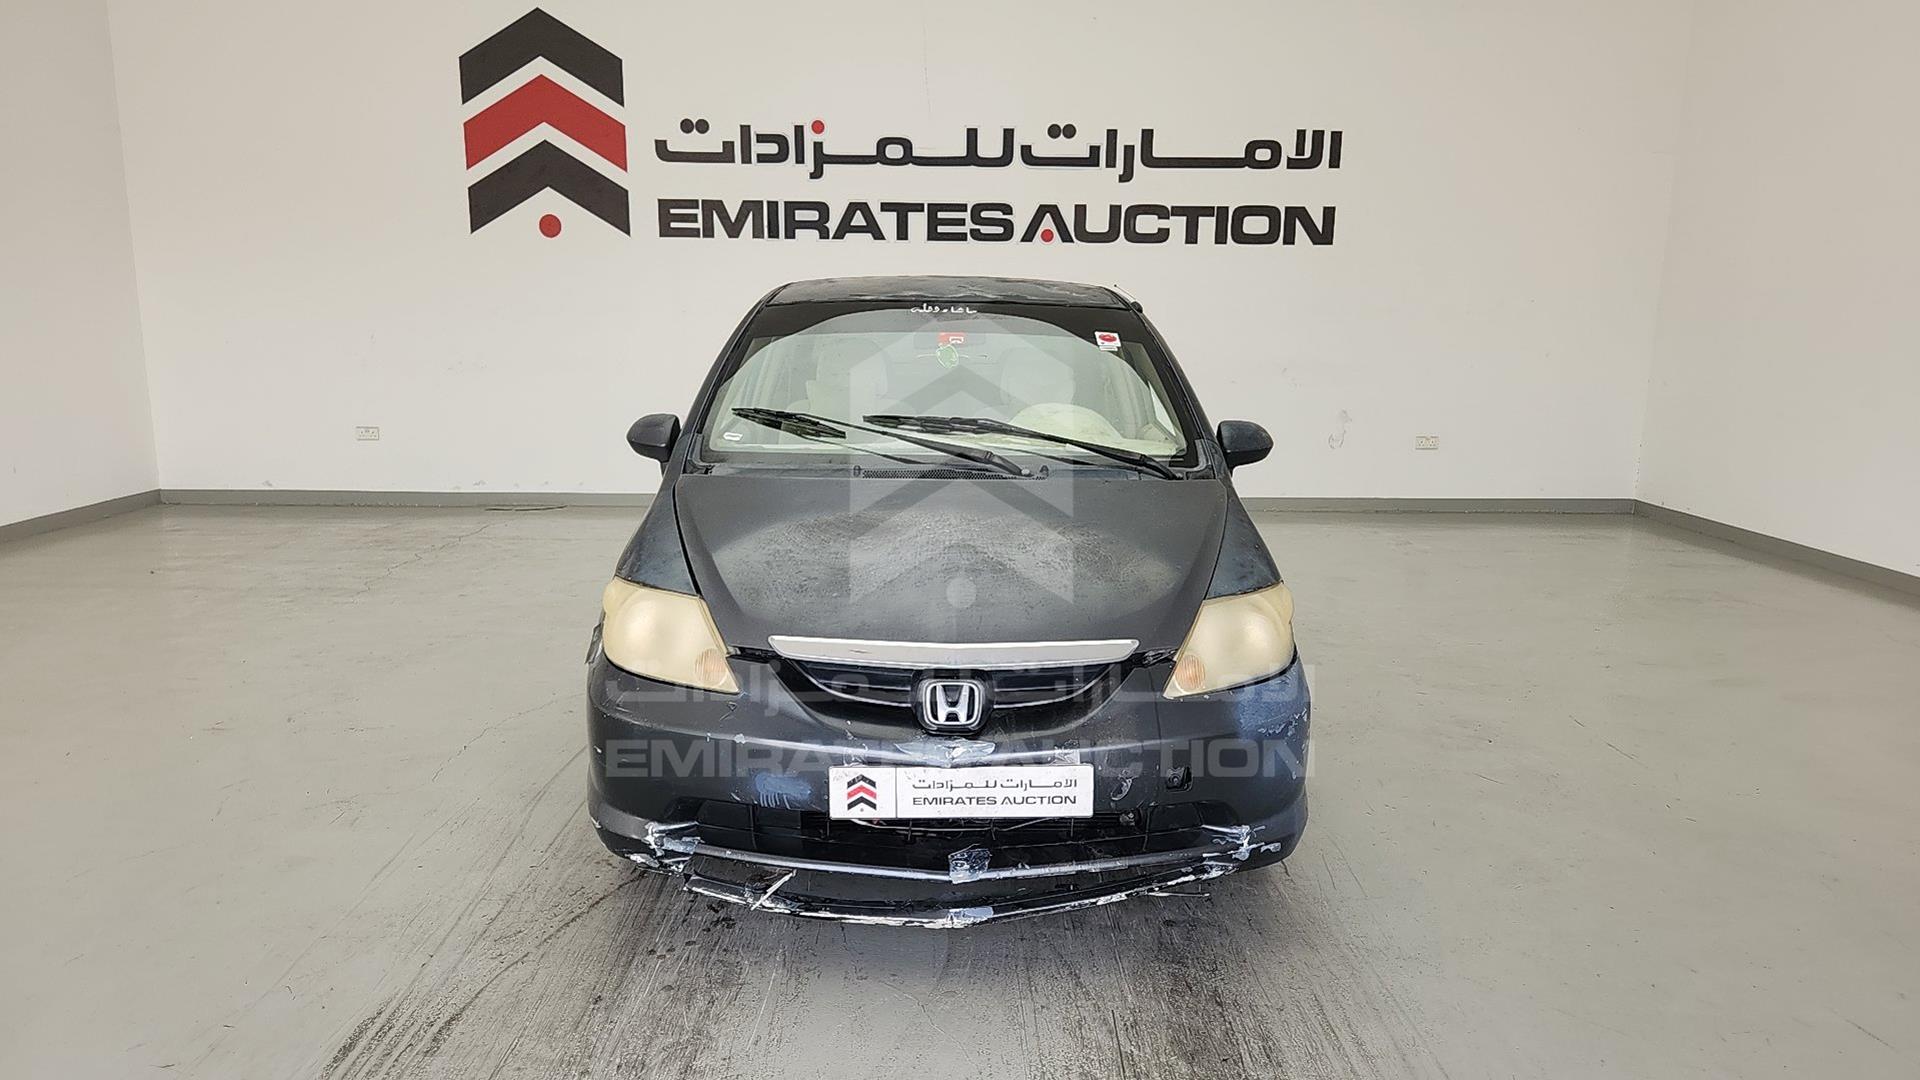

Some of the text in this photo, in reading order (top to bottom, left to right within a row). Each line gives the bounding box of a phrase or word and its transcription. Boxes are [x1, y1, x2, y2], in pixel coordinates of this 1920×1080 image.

[654, 117, 1343, 183] الامارات للمزادات
[657, 198, 1336, 245] EMIRATES AUCTION
[912, 778, 997, 793] للمزادات
[912, 795, 1077, 806] EMIRATES AUCTION
